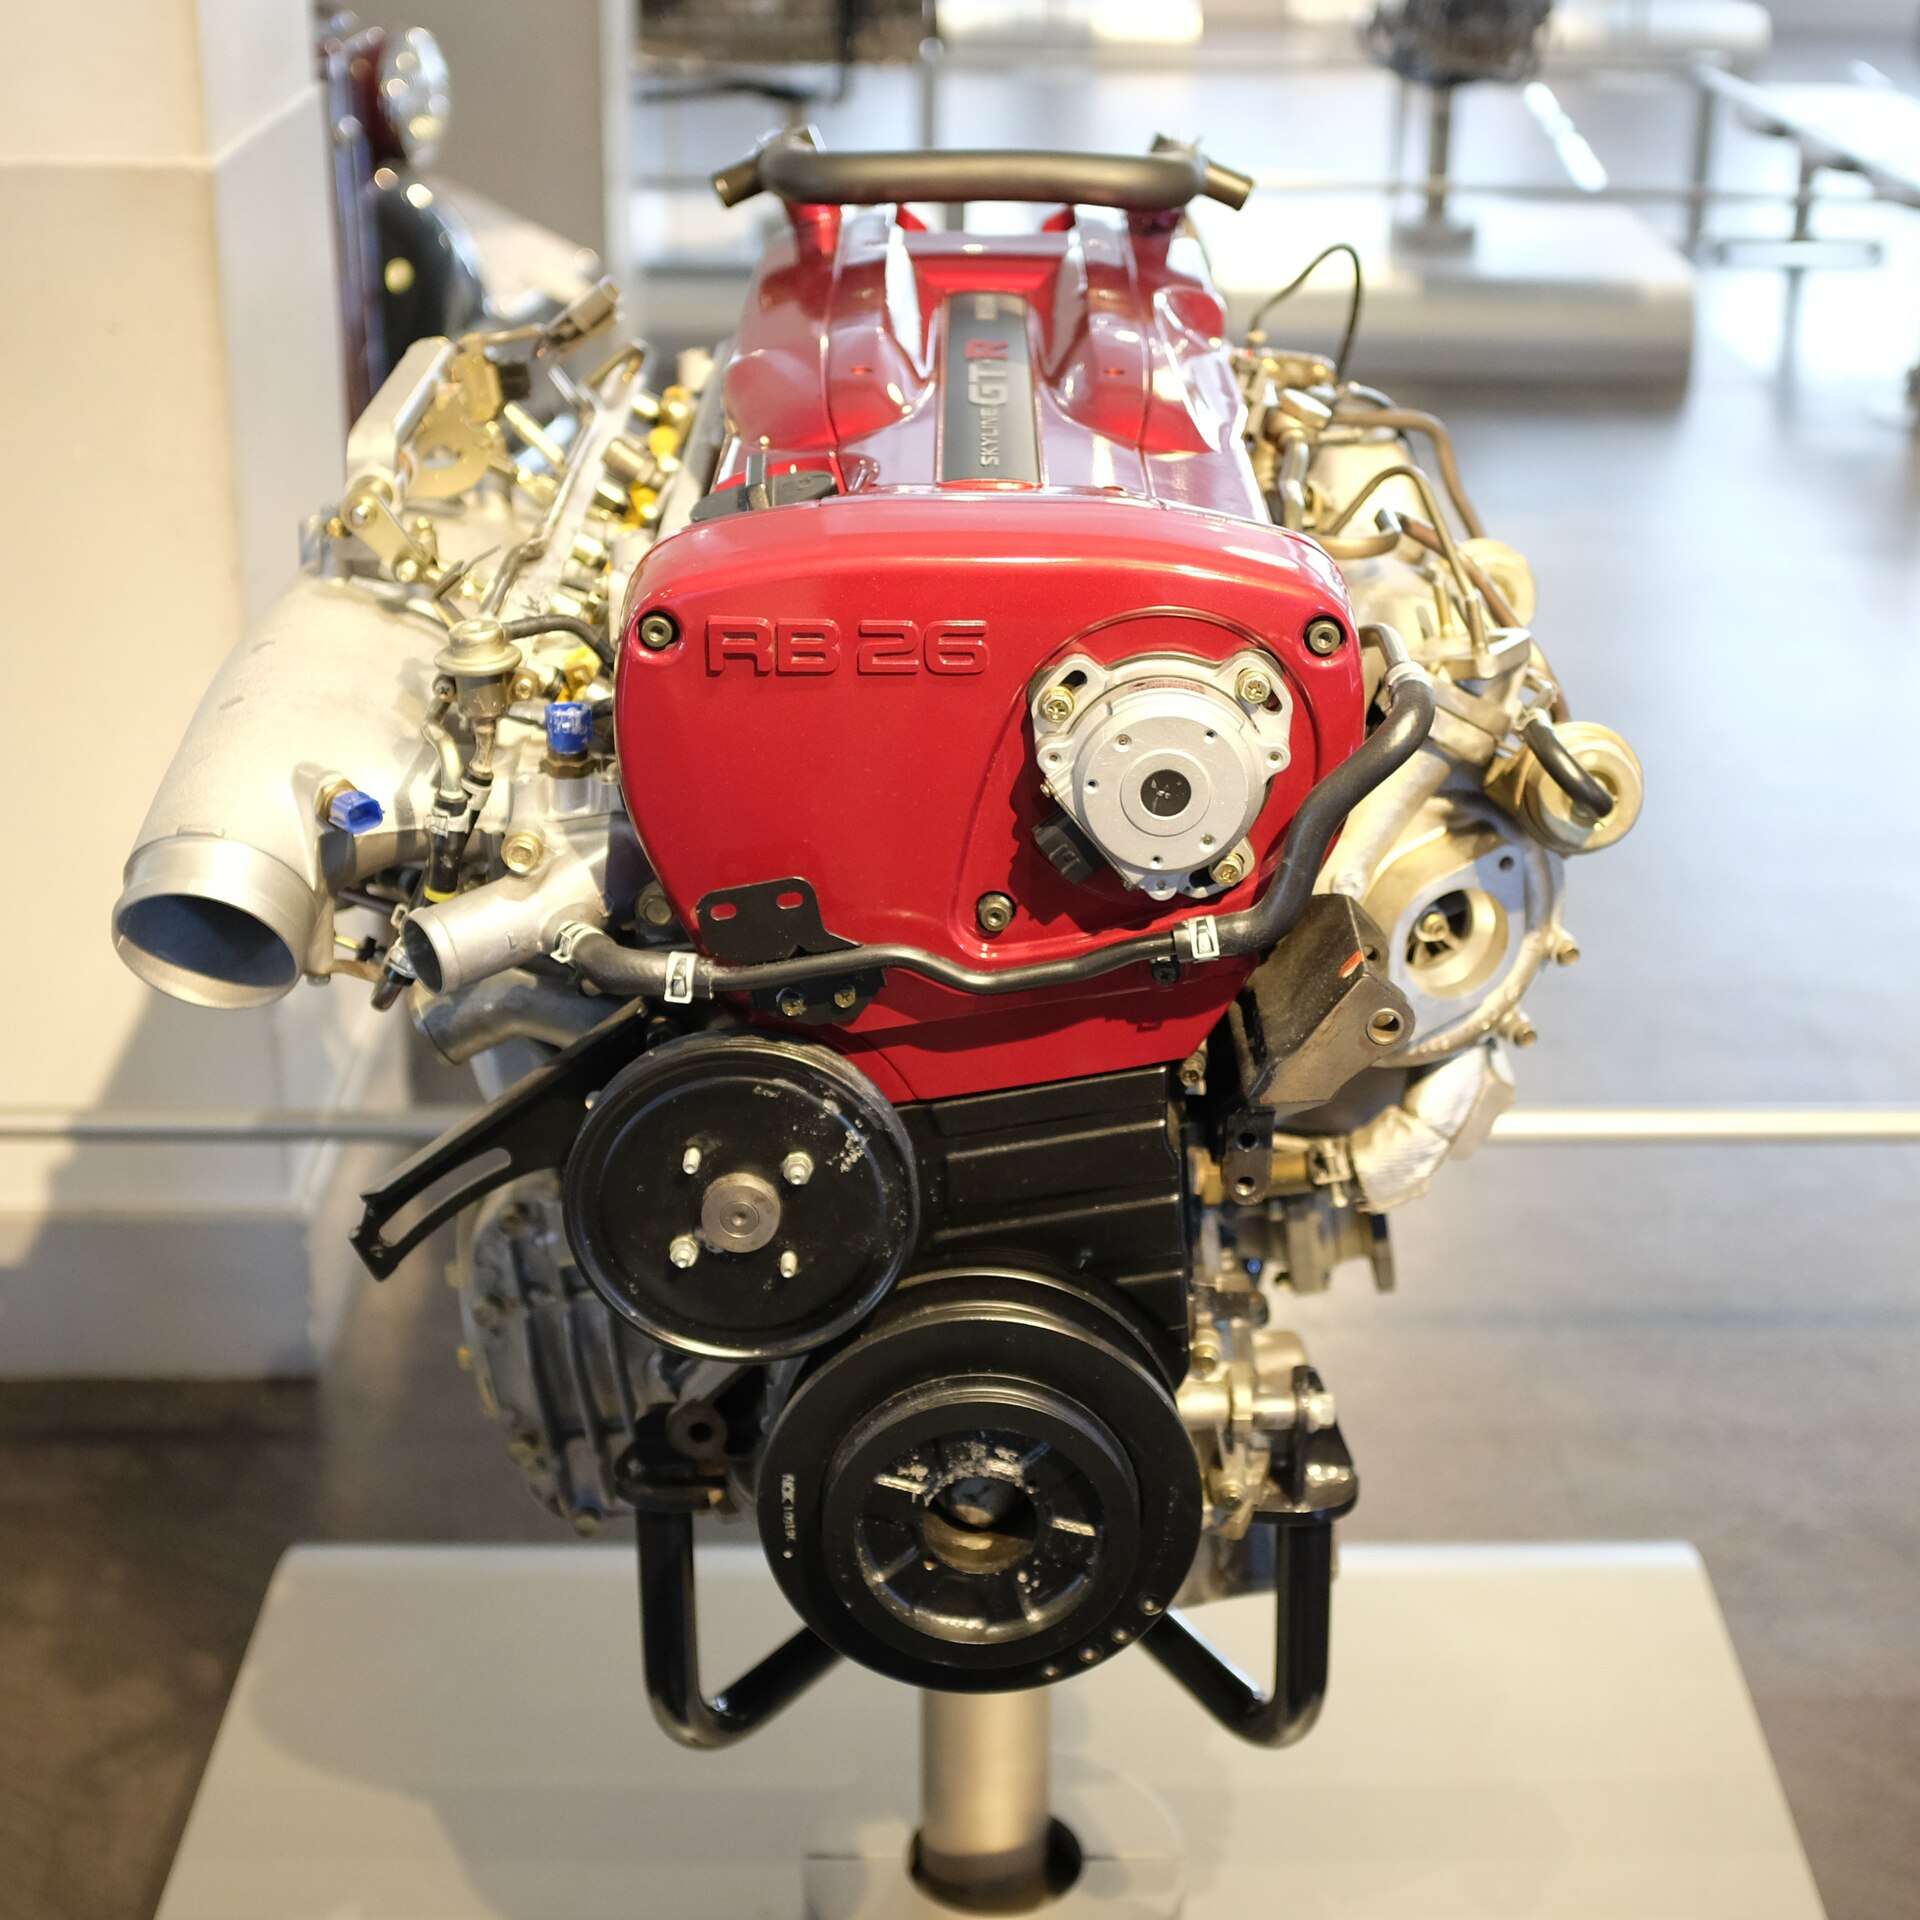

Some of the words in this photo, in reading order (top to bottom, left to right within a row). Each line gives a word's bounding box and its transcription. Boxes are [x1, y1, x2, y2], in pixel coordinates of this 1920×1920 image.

[980, 407, 1001, 467] SKYLINE
[705, 615, 841, 677] RB
[856, 619, 990, 676] 26
